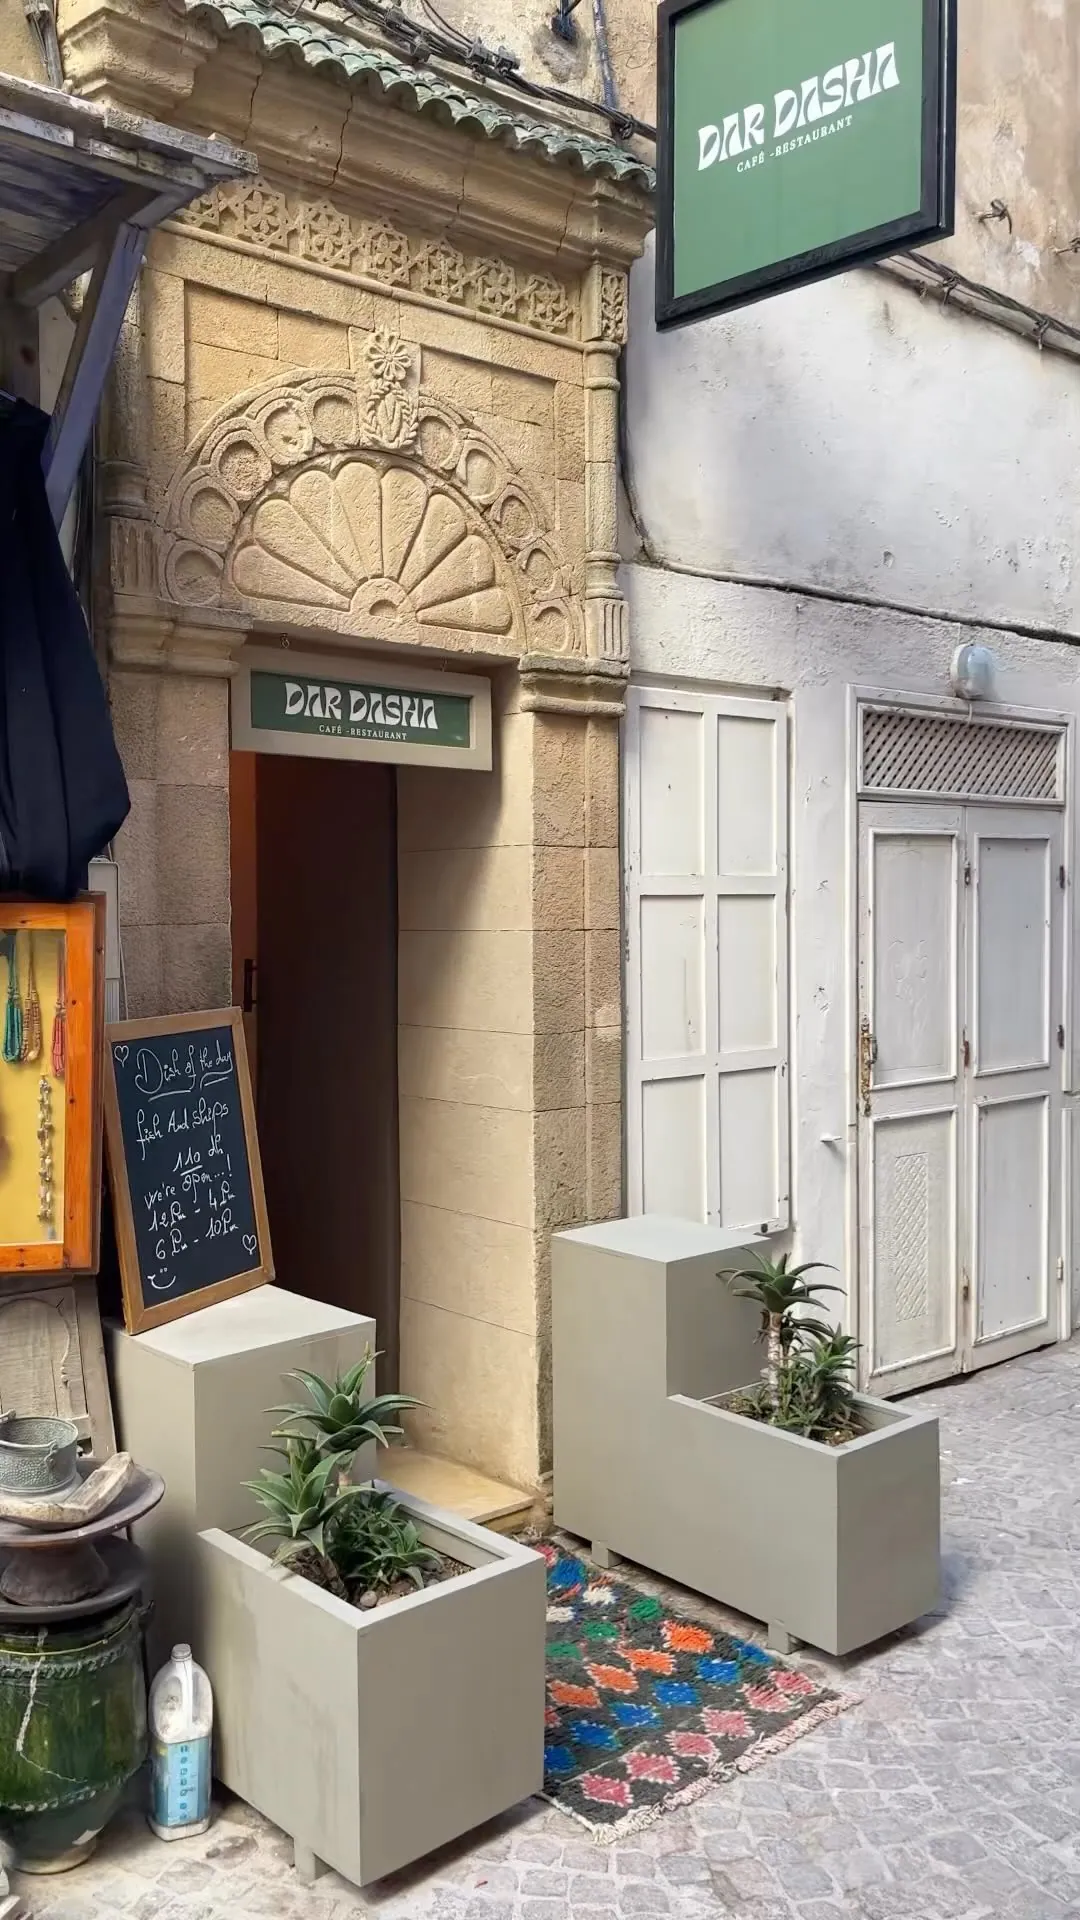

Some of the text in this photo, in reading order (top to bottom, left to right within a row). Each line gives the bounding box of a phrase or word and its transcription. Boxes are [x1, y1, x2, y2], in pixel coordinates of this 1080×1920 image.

[698, 41, 900, 171] DAR DASHA
[737, 151, 765, 173] CAFÉ
[285, 682, 438, 729] DAR DASHA
[319, 724, 342, 735] CAFÉ
[135, 1048, 181, 1094] Dish
[185, 1045, 196, 1090] of
[200, 1047, 213, 1071] the
[168, 1107, 190, 1133] And
[173, 1133, 224, 1172] 110 dh
